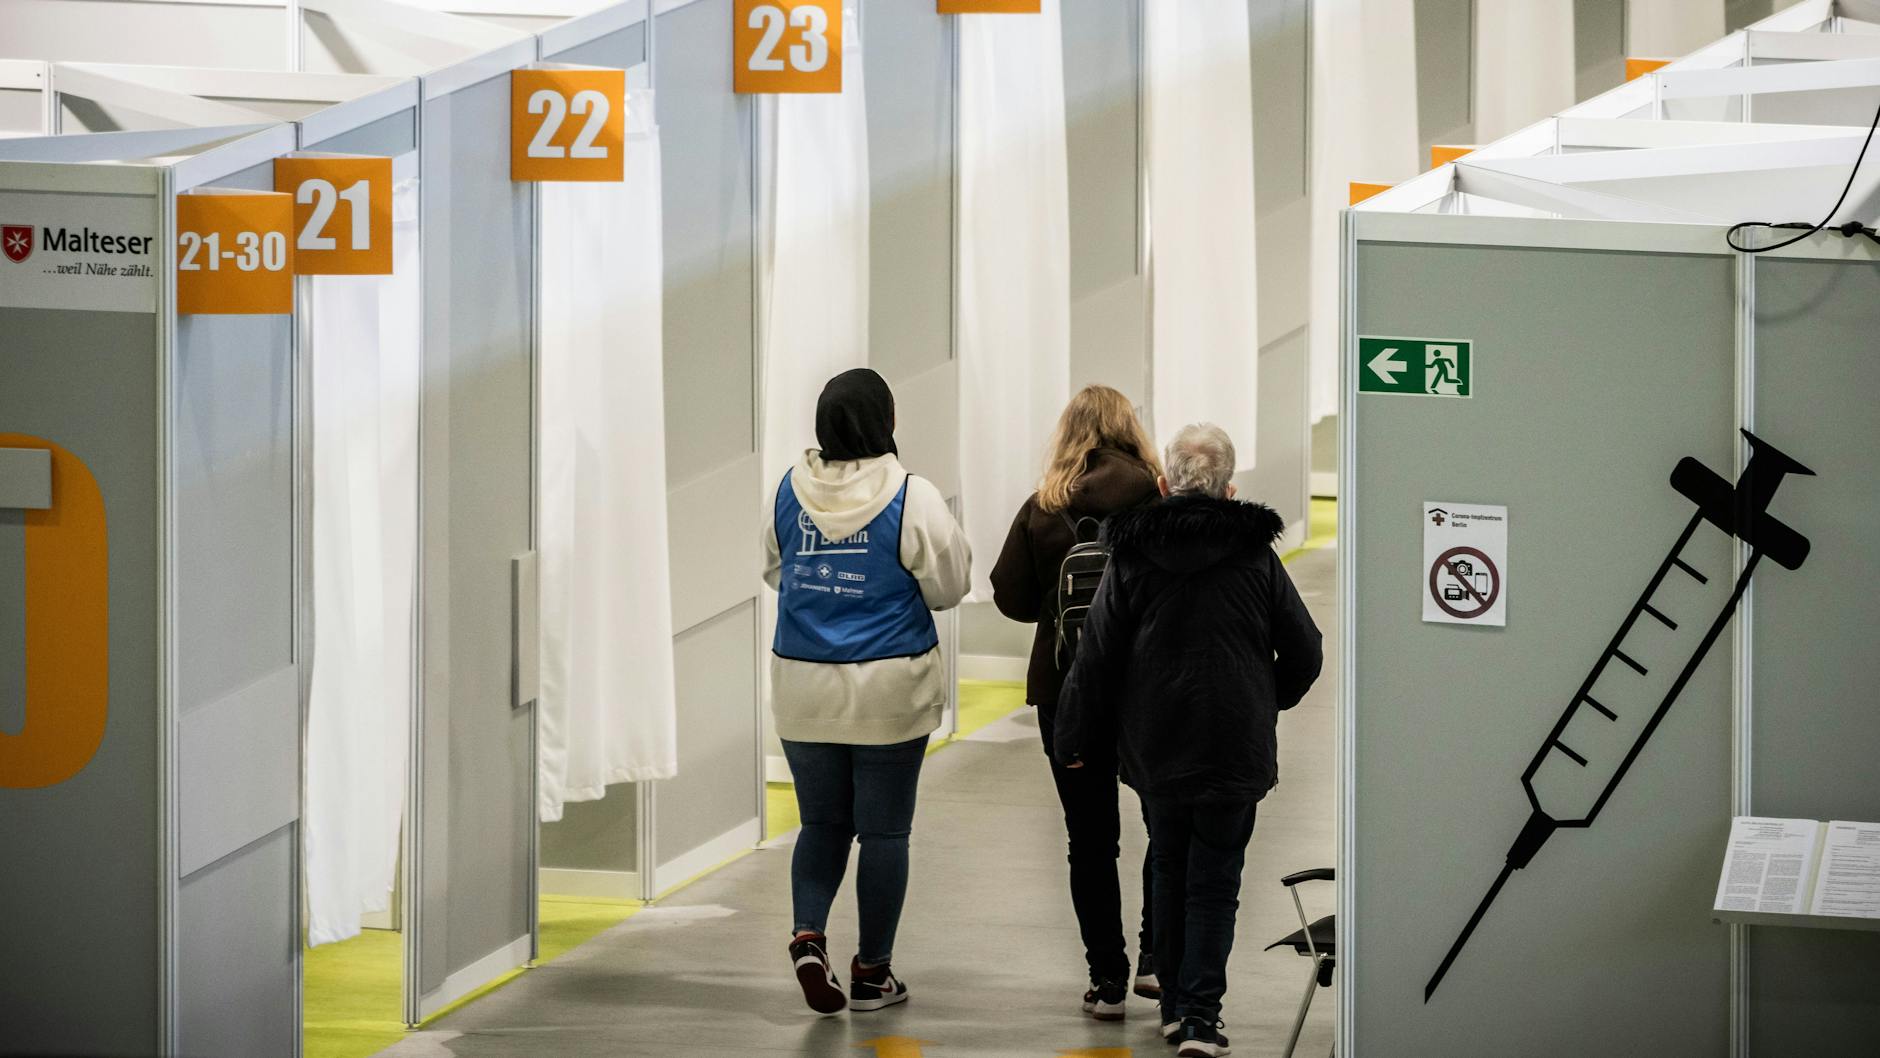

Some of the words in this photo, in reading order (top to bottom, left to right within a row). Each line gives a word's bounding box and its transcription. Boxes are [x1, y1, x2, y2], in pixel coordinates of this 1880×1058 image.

[747, 4, 828, 73] 23
[527, 89, 610, 159] 22
[43, 227, 153, 255] Malteser
[296, 178, 371, 251] 21
[85, 263, 118, 276] Nähe
[120, 264, 154, 278] zählt.
[178, 231, 286, 272] 21-30
